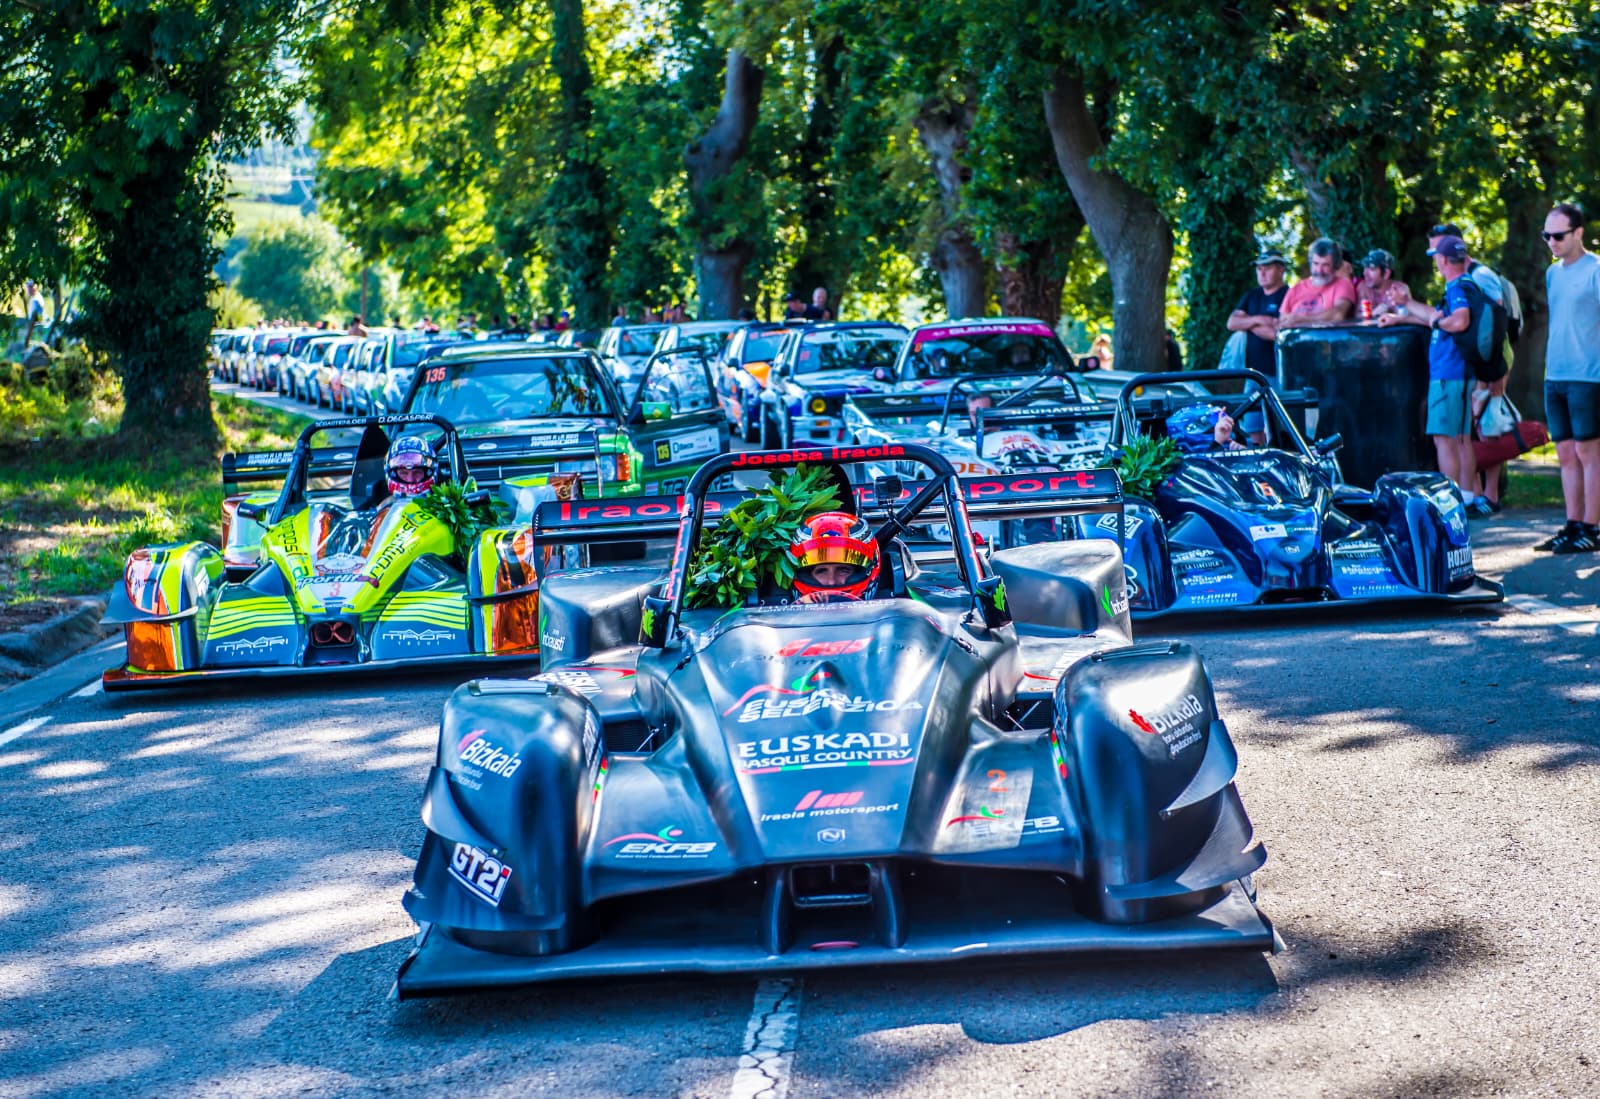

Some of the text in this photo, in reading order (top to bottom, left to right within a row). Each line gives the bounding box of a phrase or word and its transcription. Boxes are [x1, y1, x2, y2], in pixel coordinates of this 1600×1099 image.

[949, 325, 1017, 336] SUBARU
[1011, 405, 1101, 415] NEUMATICOS
[731, 443, 905, 467] Joseba Iraola
[560, 495, 721, 521] Iraola
[330, 582, 341, 598] 3
[737, 731, 910, 758] EUSKADI
[813, 748, 913, 762] COUNTRY
[459, 737, 522, 779] Bizkaia
[986, 769, 1009, 793] 2
[760, 803, 900, 822] Iraola motorsport
[619, 841, 717, 854] EKFB
[452, 842, 512, 899] GT2i
